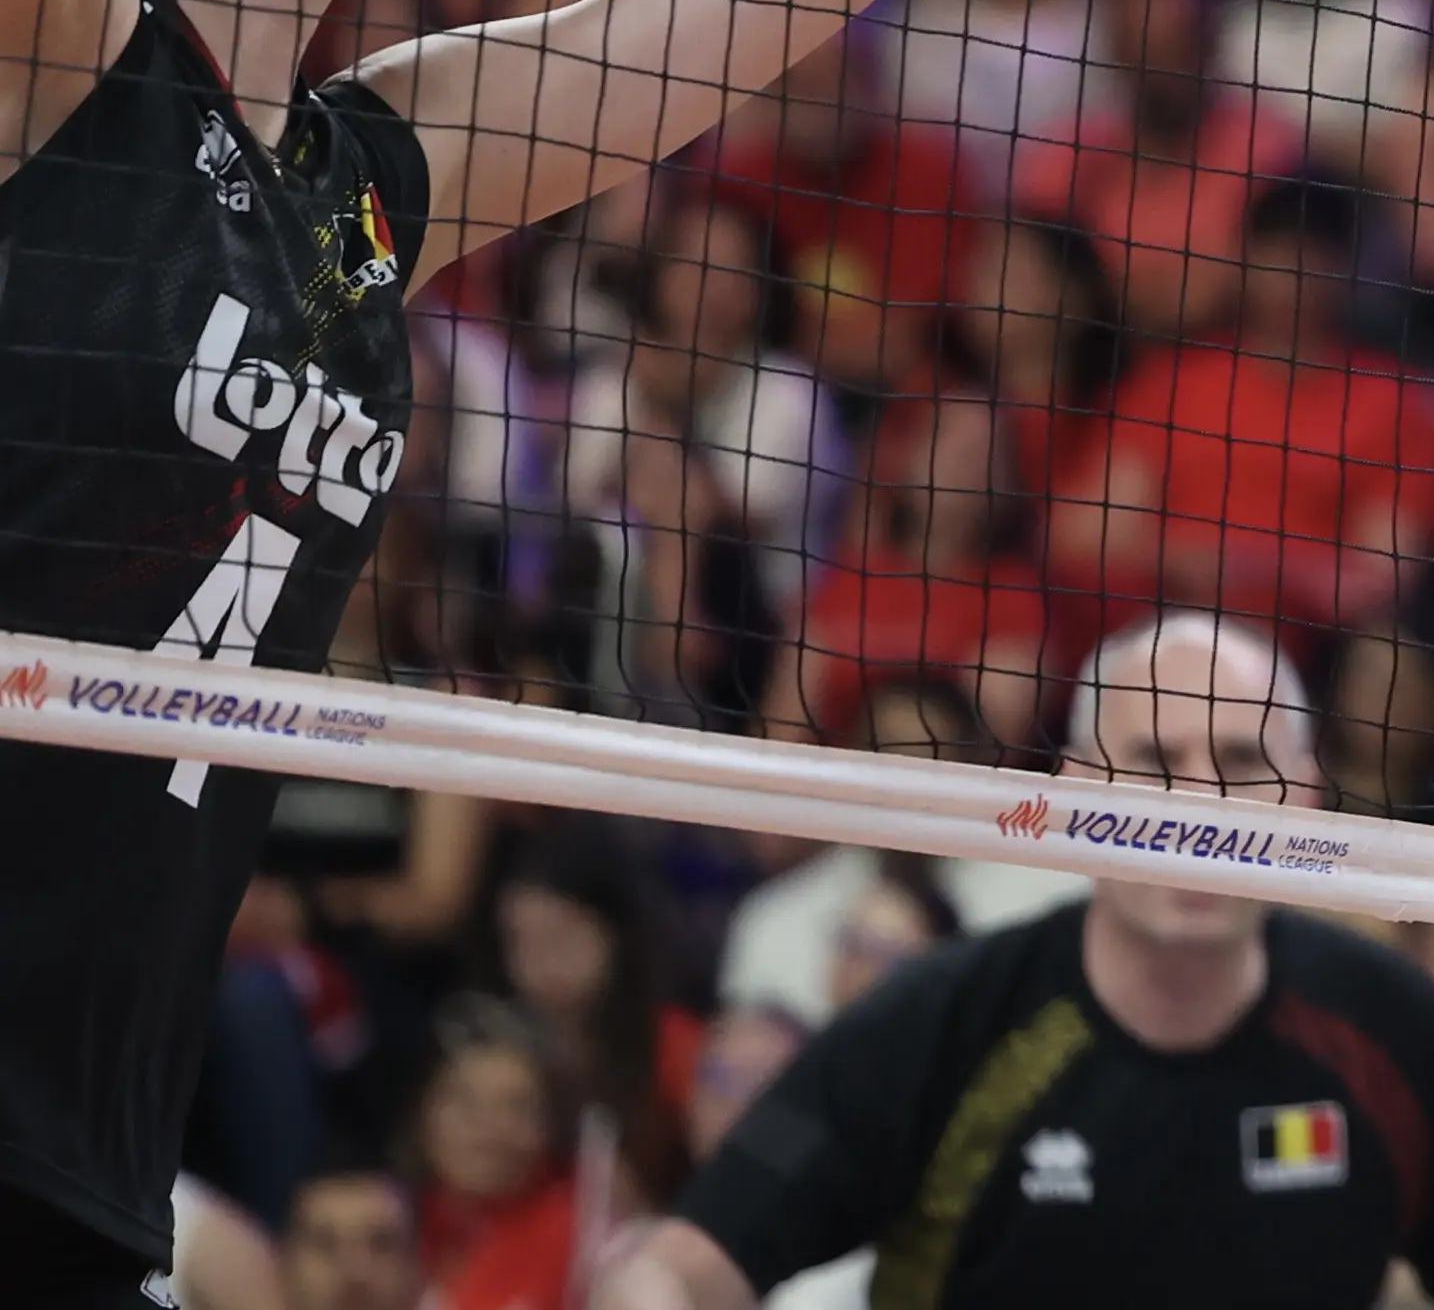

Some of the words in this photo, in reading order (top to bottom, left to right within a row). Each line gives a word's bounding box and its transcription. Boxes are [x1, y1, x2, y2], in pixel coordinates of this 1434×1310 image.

[68, 676, 303, 736] VOLLEYBALL
[316, 708, 386, 730] NATIONS
[305, 726, 368, 746] LEAGUE
[1065, 809, 1274, 867] VOLLEYBALL
[1285, 836, 1350, 858] NATIONS
[1278, 854, 1333, 875] LEAGUE
